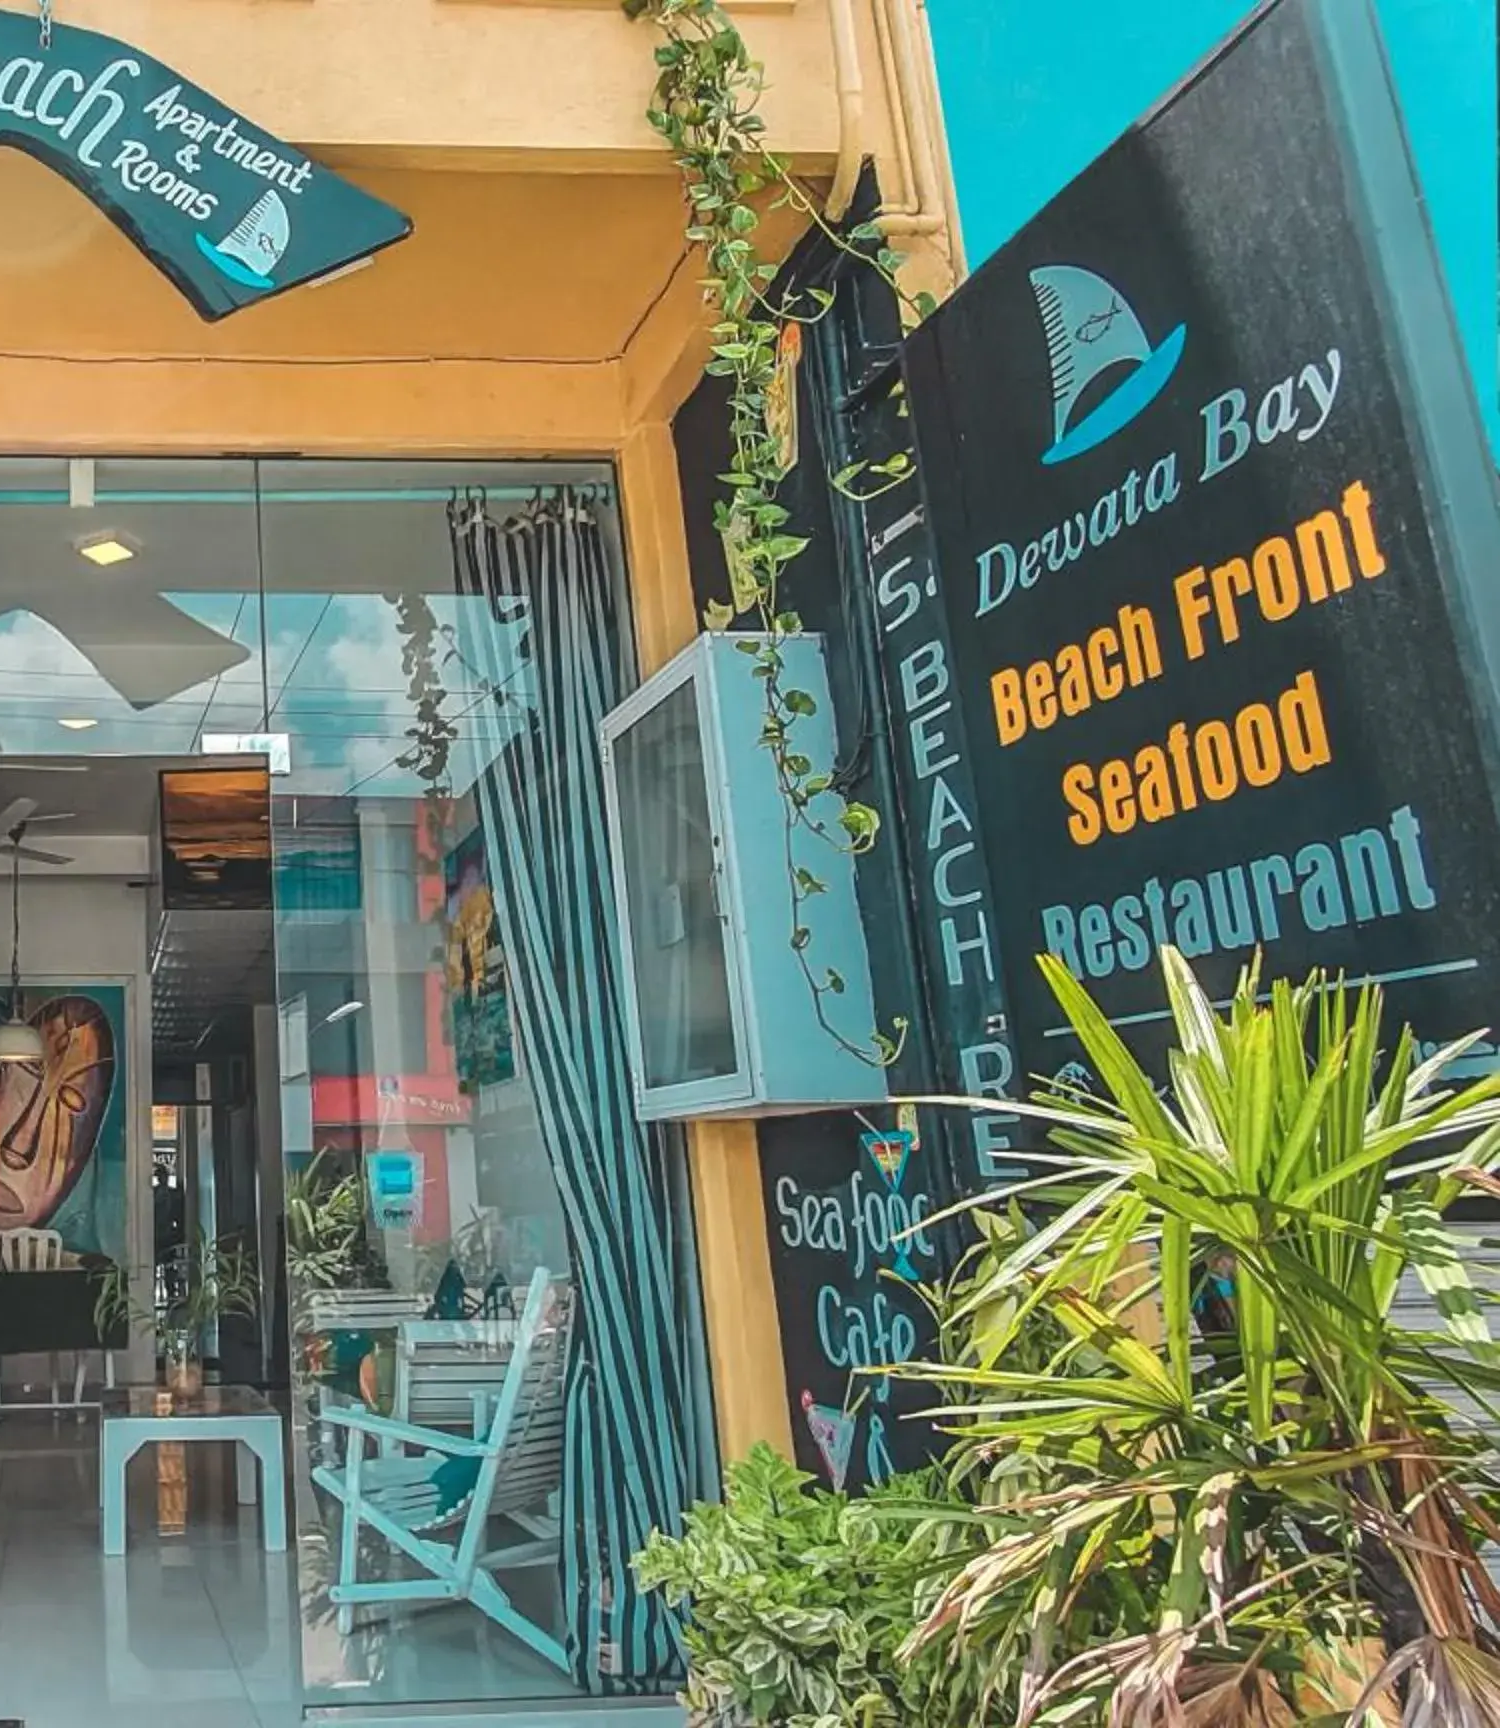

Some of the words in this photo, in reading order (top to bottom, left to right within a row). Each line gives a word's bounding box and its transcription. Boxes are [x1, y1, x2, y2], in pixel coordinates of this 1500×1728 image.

[111, 139, 219, 221] Rooms
[143, 83, 313, 194] Apartment
[175, 143, 202, 173] &
[973, 450, 1182, 620] Dewata
[1198, 346, 1344, 485] Bay
[990, 601, 1163, 748] Beach
[1172, 478, 1388, 662] Front
[1061, 671, 1332, 847] Seafood
[899, 639, 993, 987] BEACH
[959, 1041, 1030, 1190] RE
[1040, 803, 1437, 983] Restaurant
[817, 1285, 916, 1403] Cafe
